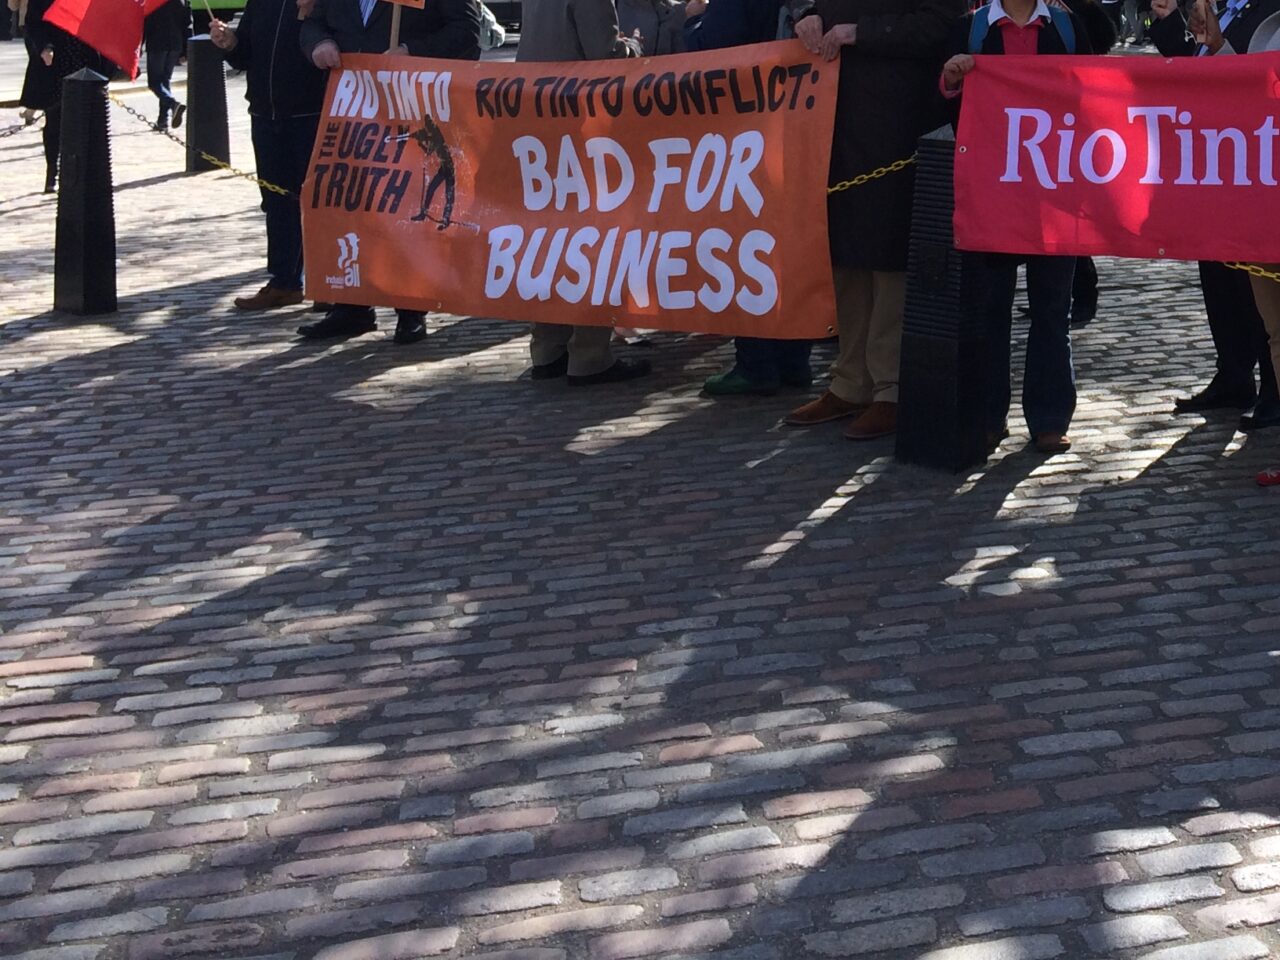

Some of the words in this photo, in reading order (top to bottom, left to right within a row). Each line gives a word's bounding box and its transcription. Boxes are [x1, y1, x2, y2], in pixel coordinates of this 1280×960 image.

[329, 69, 380, 119] RIO
[377, 70, 452, 122] TINTO
[476, 76, 525, 120] RIO
[533, 75, 626, 118] TINTO
[633, 63, 820, 117] CONFLICT:
[318, 122, 341, 160] THE
[337, 120, 410, 164] UGLY
[311, 162, 413, 214] TRUTH
[512, 134, 635, 213] BAD
[647, 130, 764, 217] FOR
[344, 263, 360, 287] all
[484, 224, 779, 316] BUSINESS
